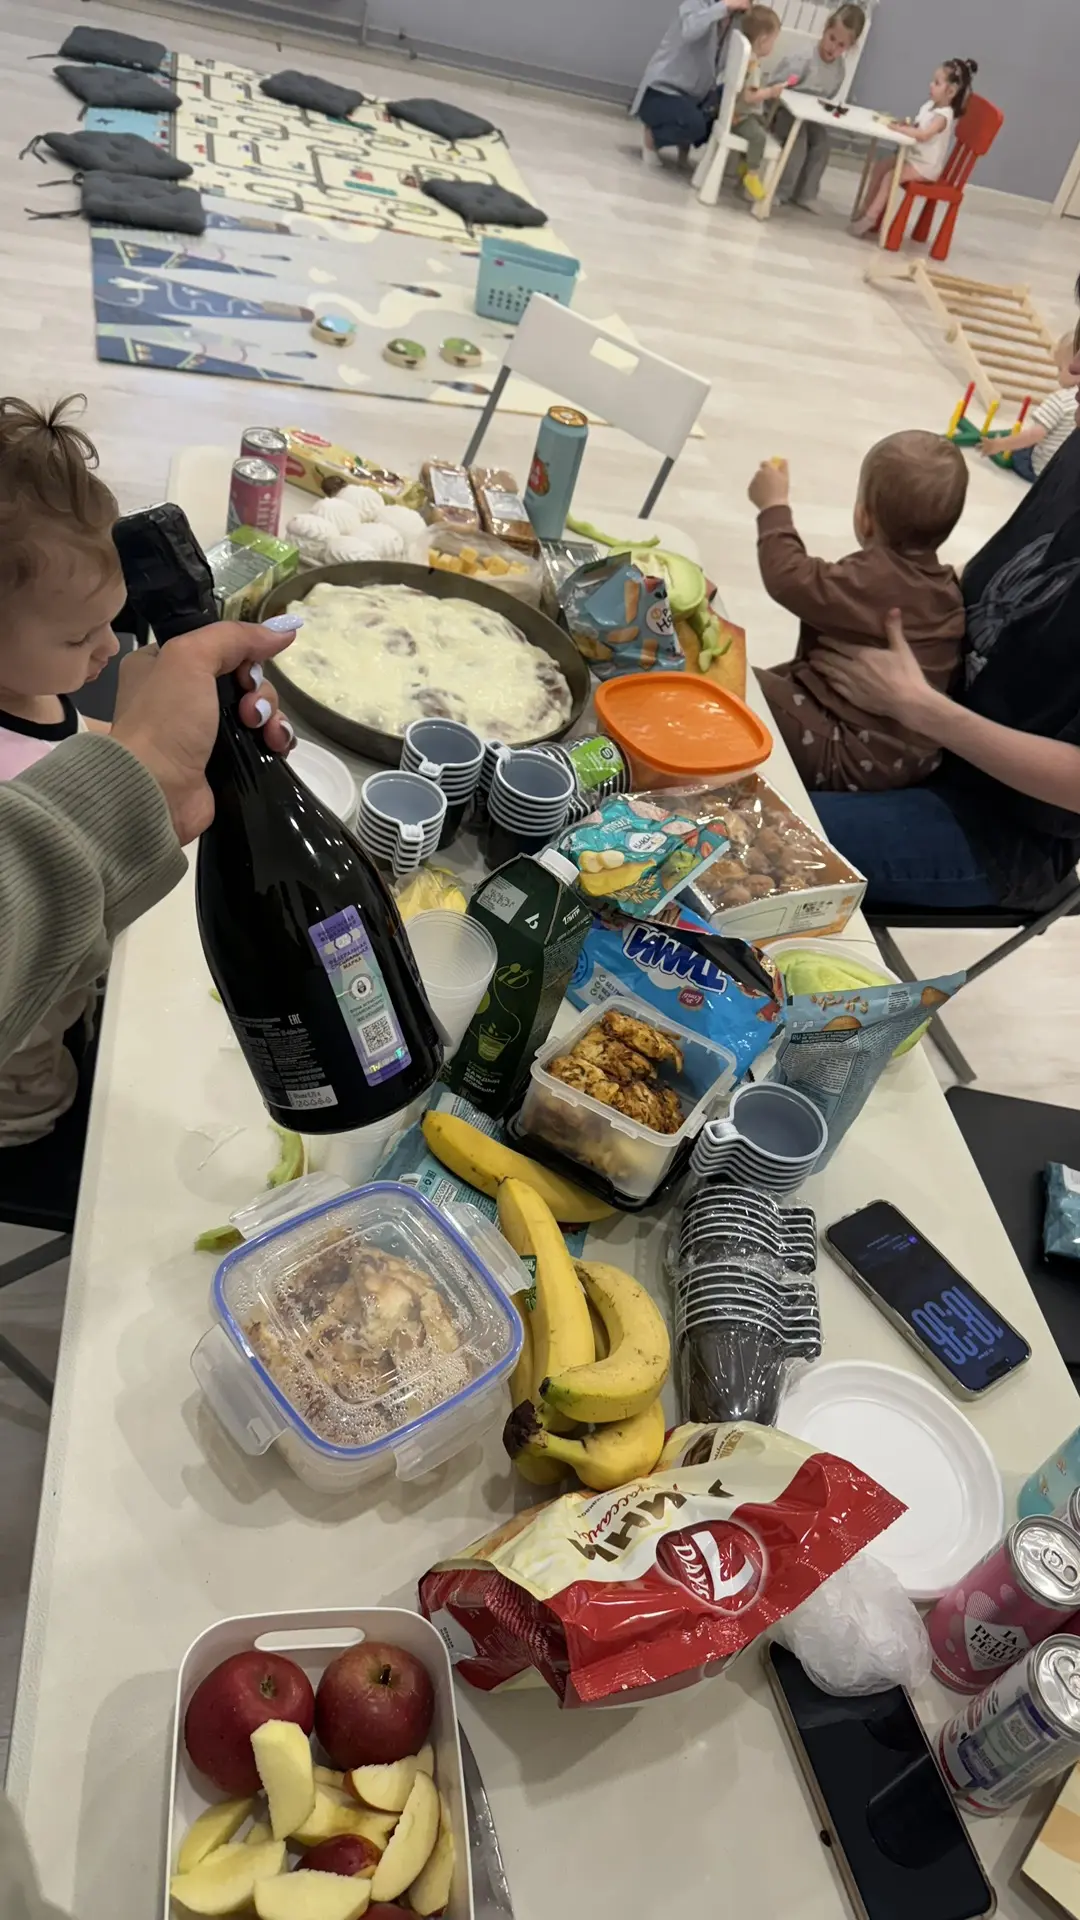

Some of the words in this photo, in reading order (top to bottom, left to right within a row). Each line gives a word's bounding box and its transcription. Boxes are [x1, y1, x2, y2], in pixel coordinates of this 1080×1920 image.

[911, 1285, 1005, 1366] 18:36
[671, 1538, 711, 1601] DAYS
[691, 1530, 755, 1601] 7
[1002, 1629, 1018, 1646] LA
